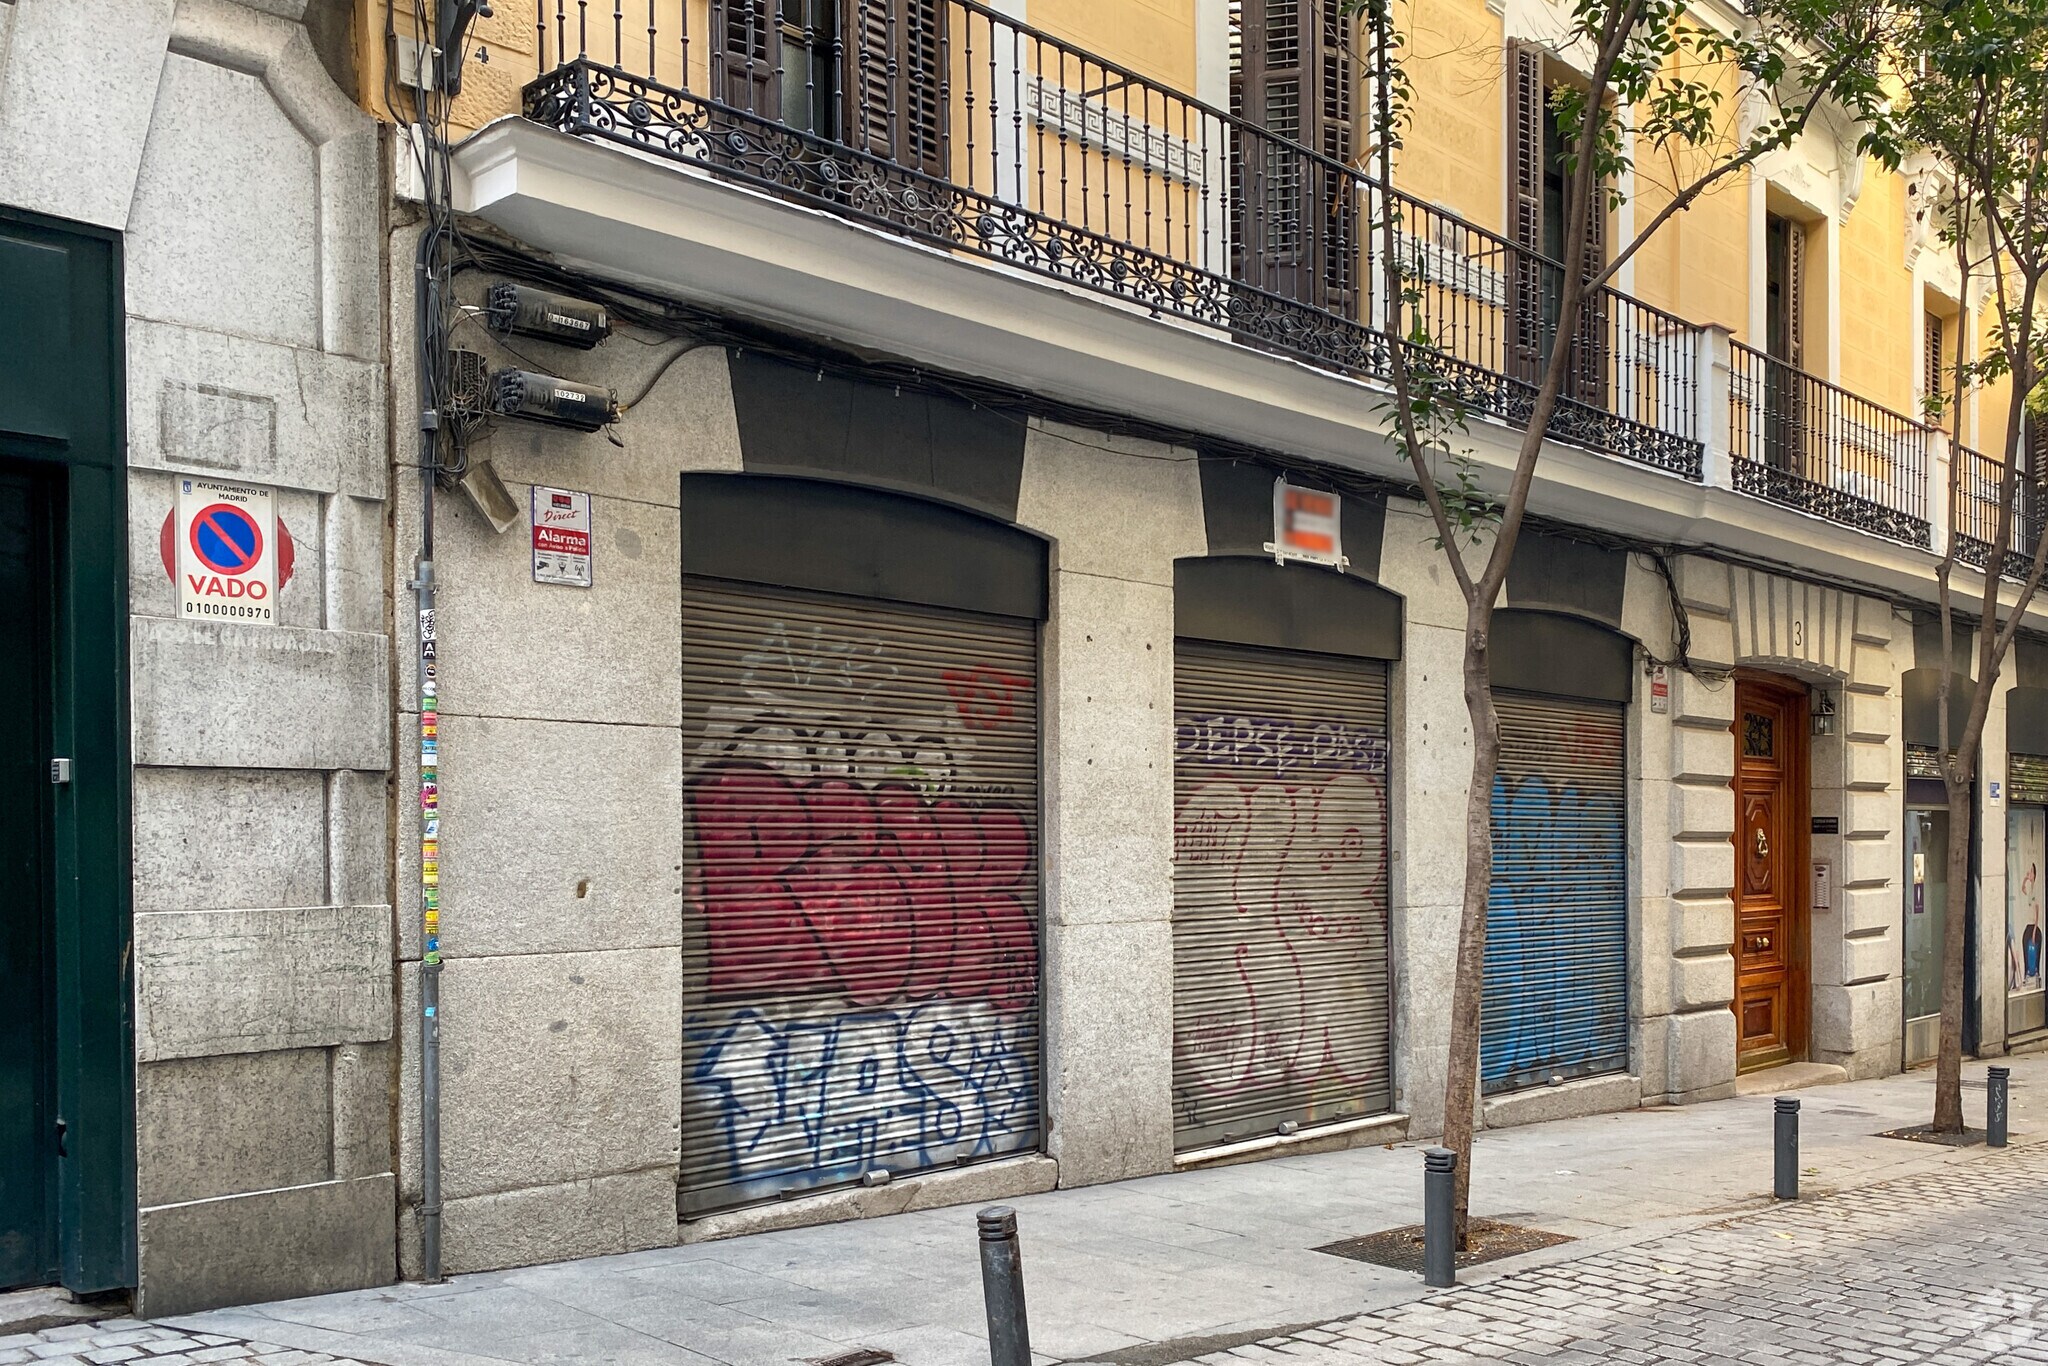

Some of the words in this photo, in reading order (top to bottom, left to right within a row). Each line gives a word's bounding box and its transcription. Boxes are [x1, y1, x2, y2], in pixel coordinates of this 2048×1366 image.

[474, 45, 489, 64] 4
[556, 390, 585, 402] 102732
[197, 482, 257, 496] AYUNTAMIENTO
[218, 493, 248, 502] MADRID
[544, 509, 580, 522] Direct
[539, 529, 586, 545] Alarma
[187, 573, 268, 600] VADO
[186, 602, 270, 619] 0100000970
[1794, 621, 1802, 646] 3
